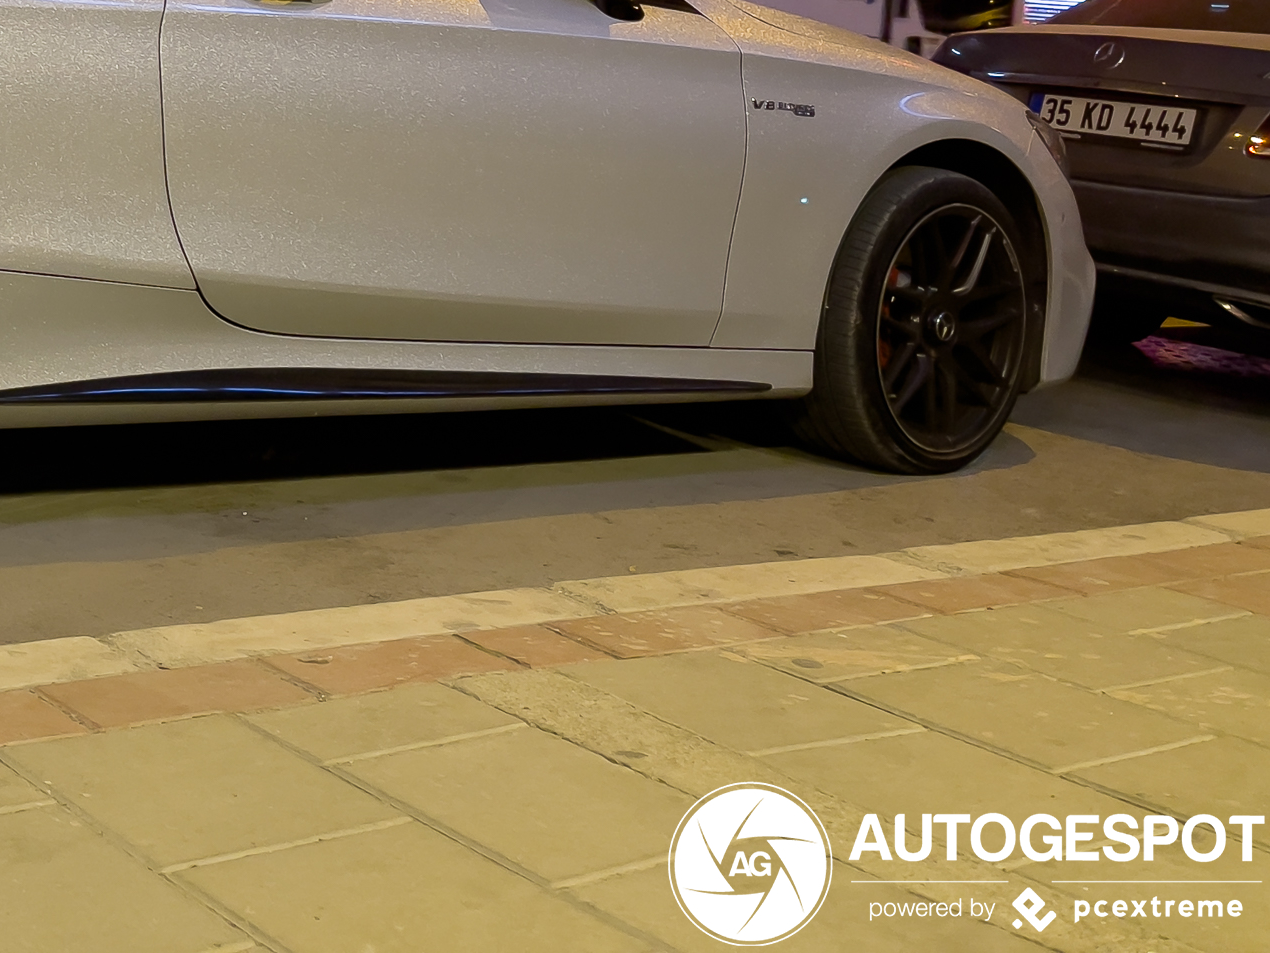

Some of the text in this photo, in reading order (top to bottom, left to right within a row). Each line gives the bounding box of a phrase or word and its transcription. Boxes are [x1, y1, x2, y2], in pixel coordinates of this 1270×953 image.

[1042, 98, 1187, 140] 35 KD 4444
